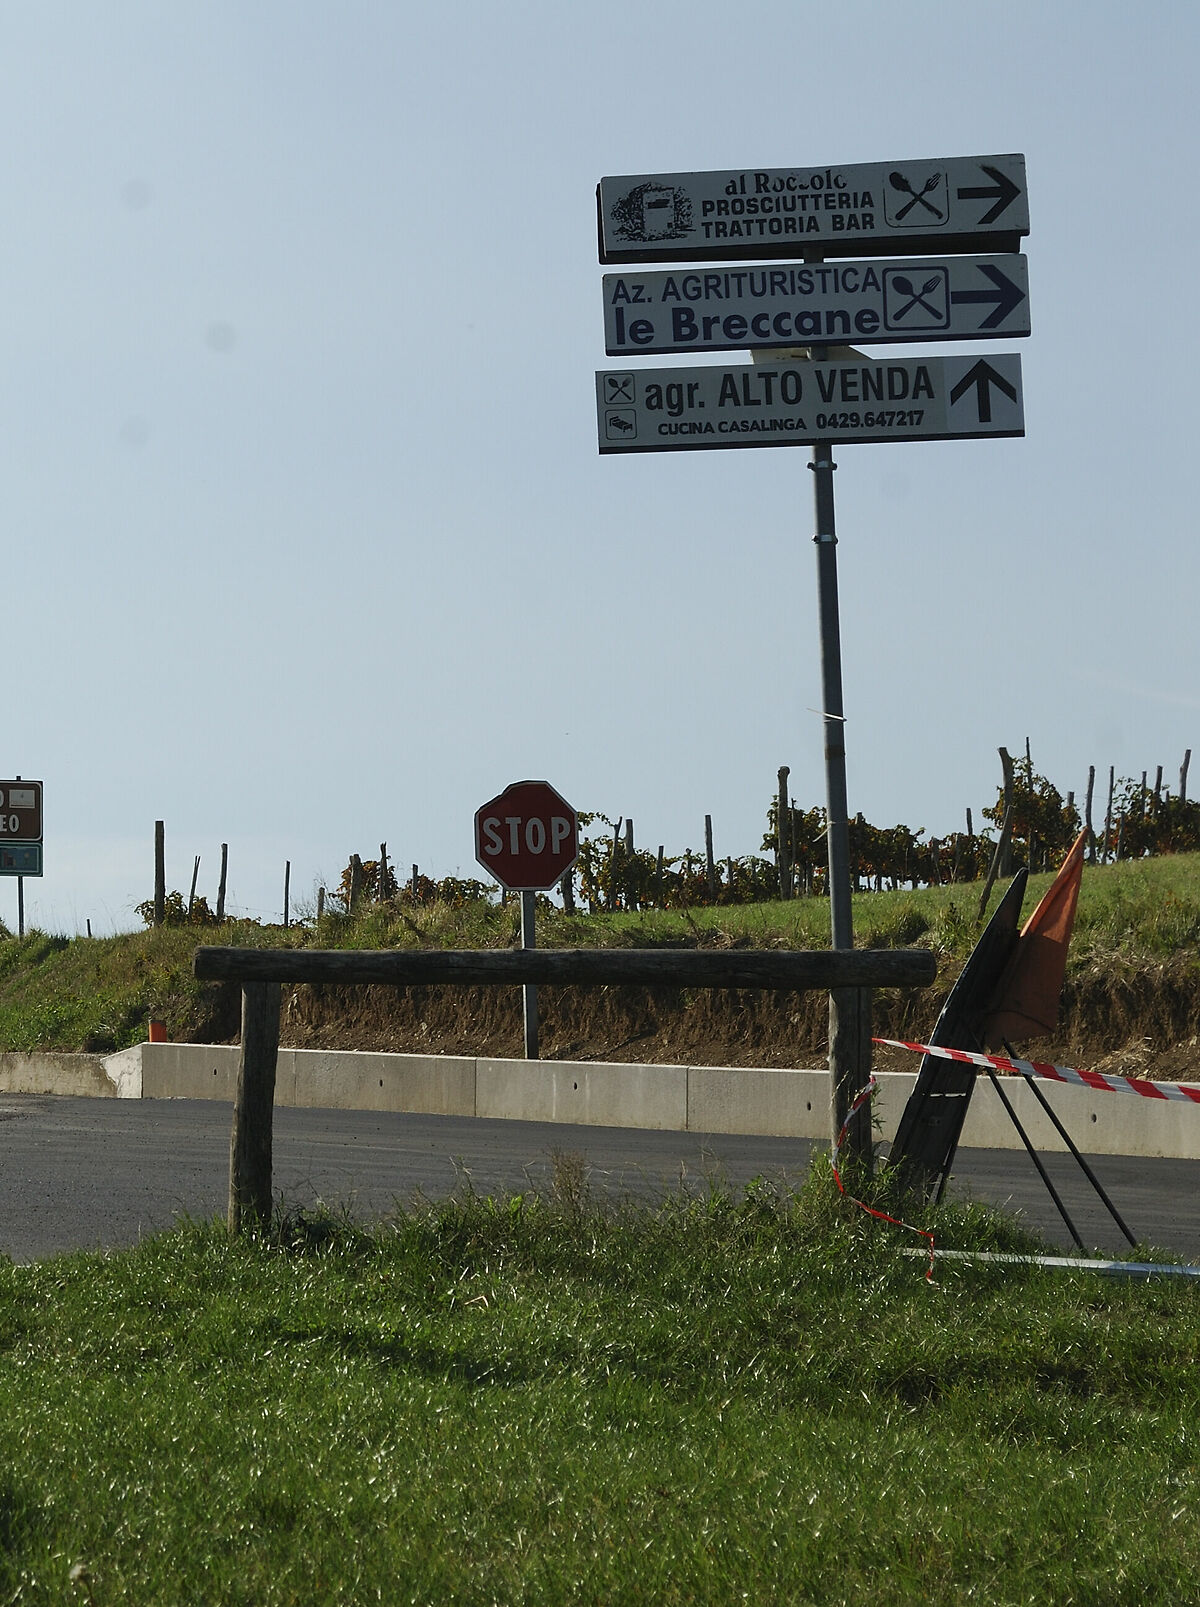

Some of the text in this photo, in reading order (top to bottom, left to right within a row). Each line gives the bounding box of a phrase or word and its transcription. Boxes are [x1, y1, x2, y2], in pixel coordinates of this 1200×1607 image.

[725, 174, 746, 195] al
[702, 191, 875, 217] PROSCIUTTERIA
[701, 213, 875, 239] TRATTORIA BAR
[611, 267, 882, 304] Az. AGRITURISTICA
[615, 306, 881, 346] le Breccane
[645, 365, 935, 417] agr. ALTO VENDA
[657, 409, 924, 436] CUCINA CASALINGA 0429.647217
[482, 816, 571, 856] STOP
